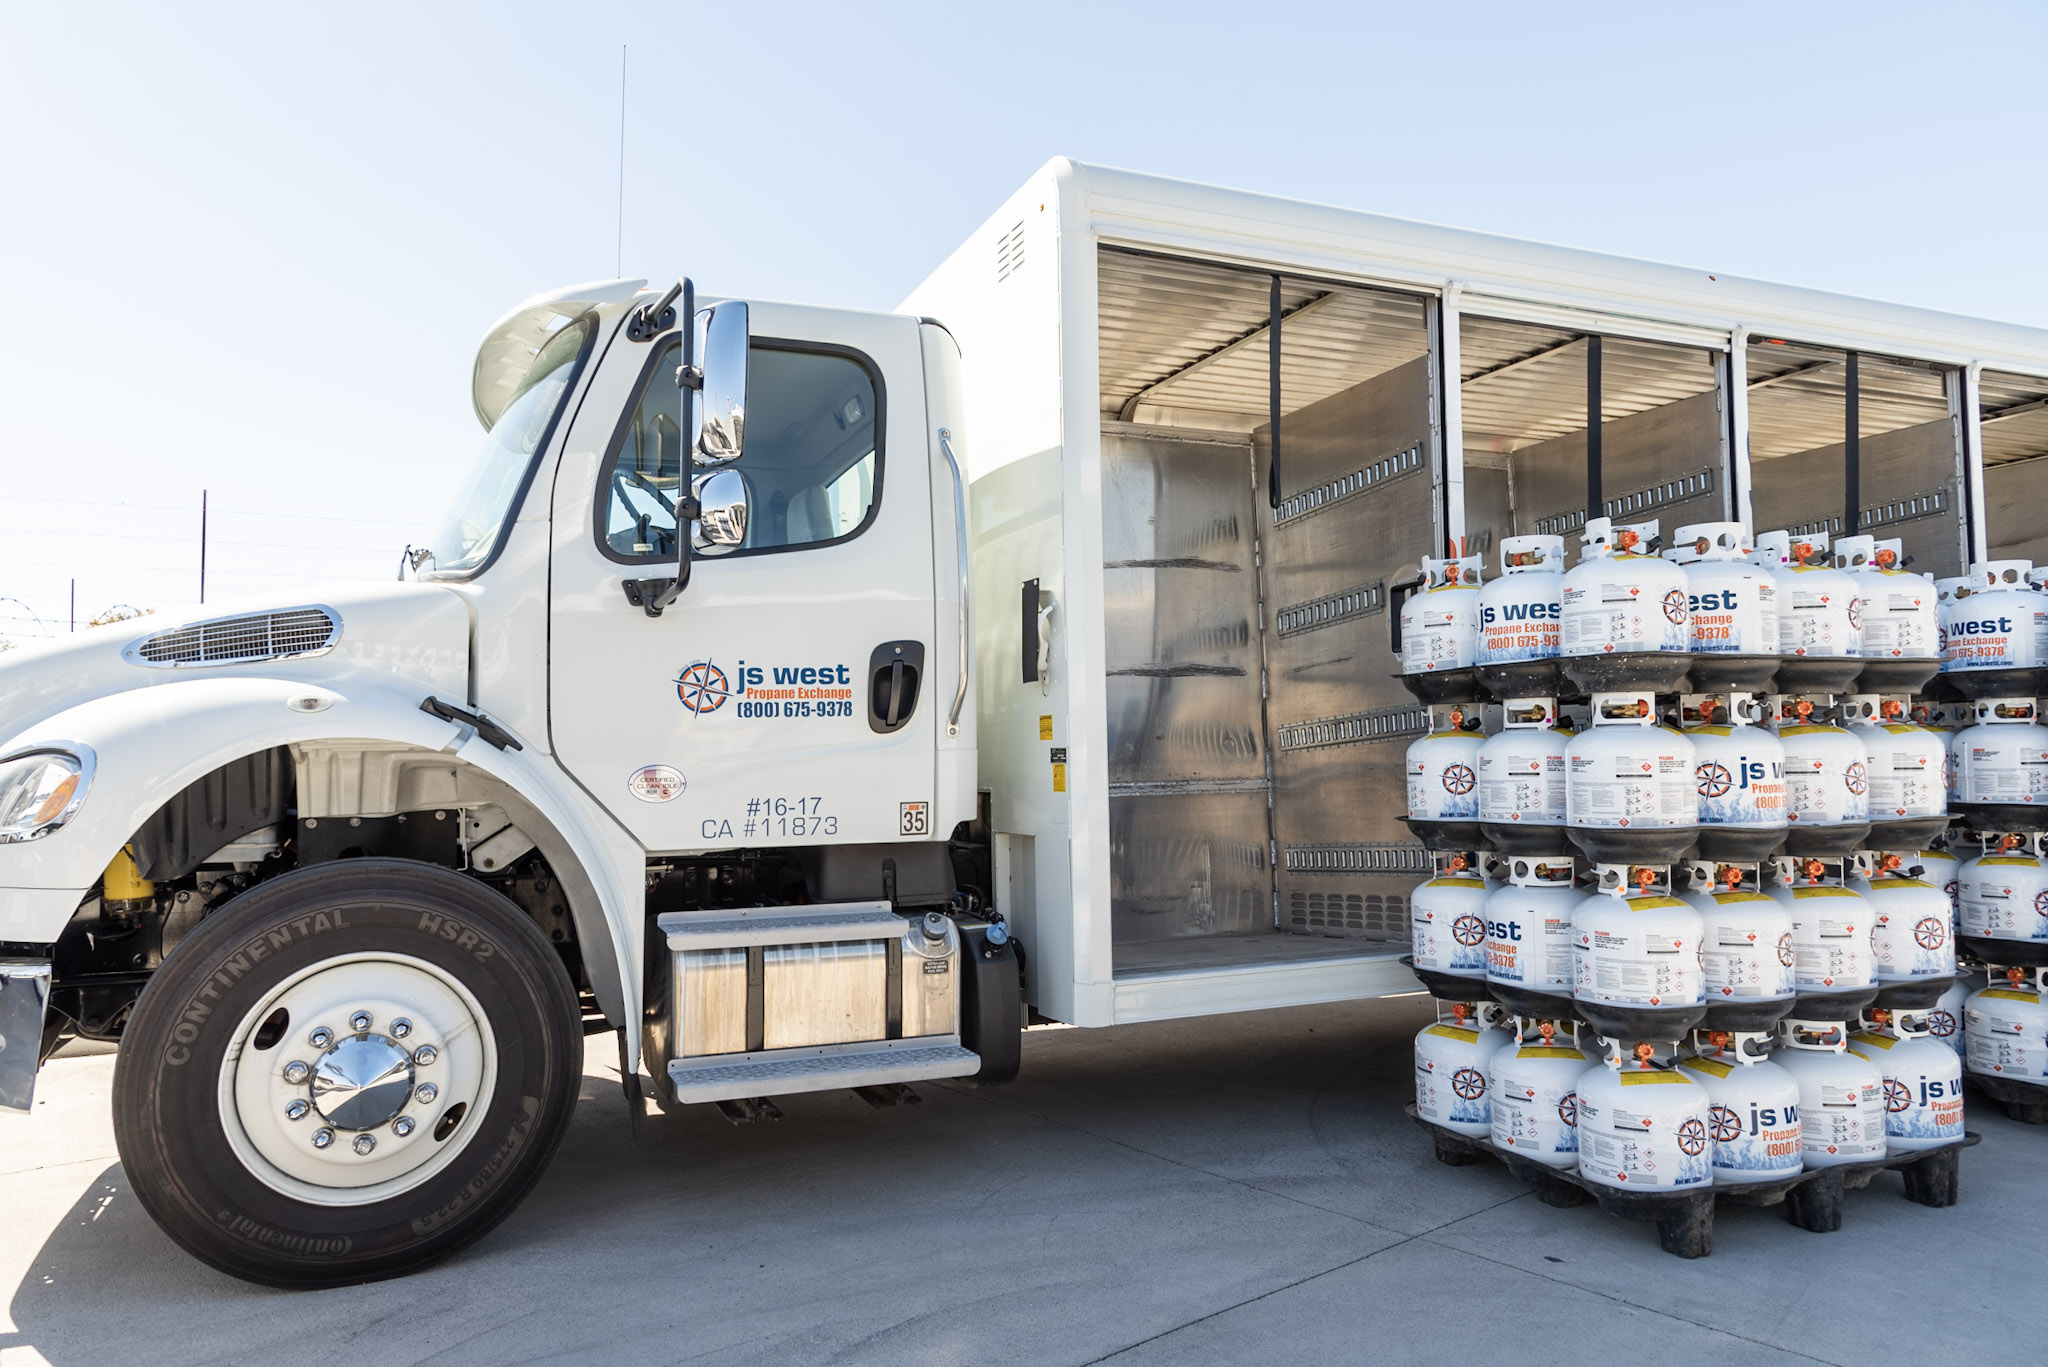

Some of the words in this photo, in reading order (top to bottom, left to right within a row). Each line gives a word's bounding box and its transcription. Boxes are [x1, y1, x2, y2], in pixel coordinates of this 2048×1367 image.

[1480, 602, 1496, 634] js
[1484, 622, 1522, 636] Propane
[1950, 616, 2013, 637] west
[1487, 636, 1514, 650] (800)
[1958, 646, 2005, 658] 675-9378
[1962, 636, 2008, 647] Exchange
[736, 659, 764, 695] js
[772, 663, 851, 685] west
[746, 686, 796, 701] Propane
[797, 686, 852, 701] Exchange
[737, 701, 780, 718] (800)
[783, 700, 853, 718] 675-9378
[1739, 756, 1766, 790] js
[747, 797, 822, 817] #16-17
[701, 819, 733, 839] CA
[743, 816, 839, 838] #11873
[903, 810, 925, 832] 35
[164, 908, 351, 1067] CONTINENTAL
[417, 910, 499, 964] HSR2
[1919, 1075, 1944, 1107] js
[1749, 1102, 1777, 1137] js
[228, 1212, 353, 1257] Continental
